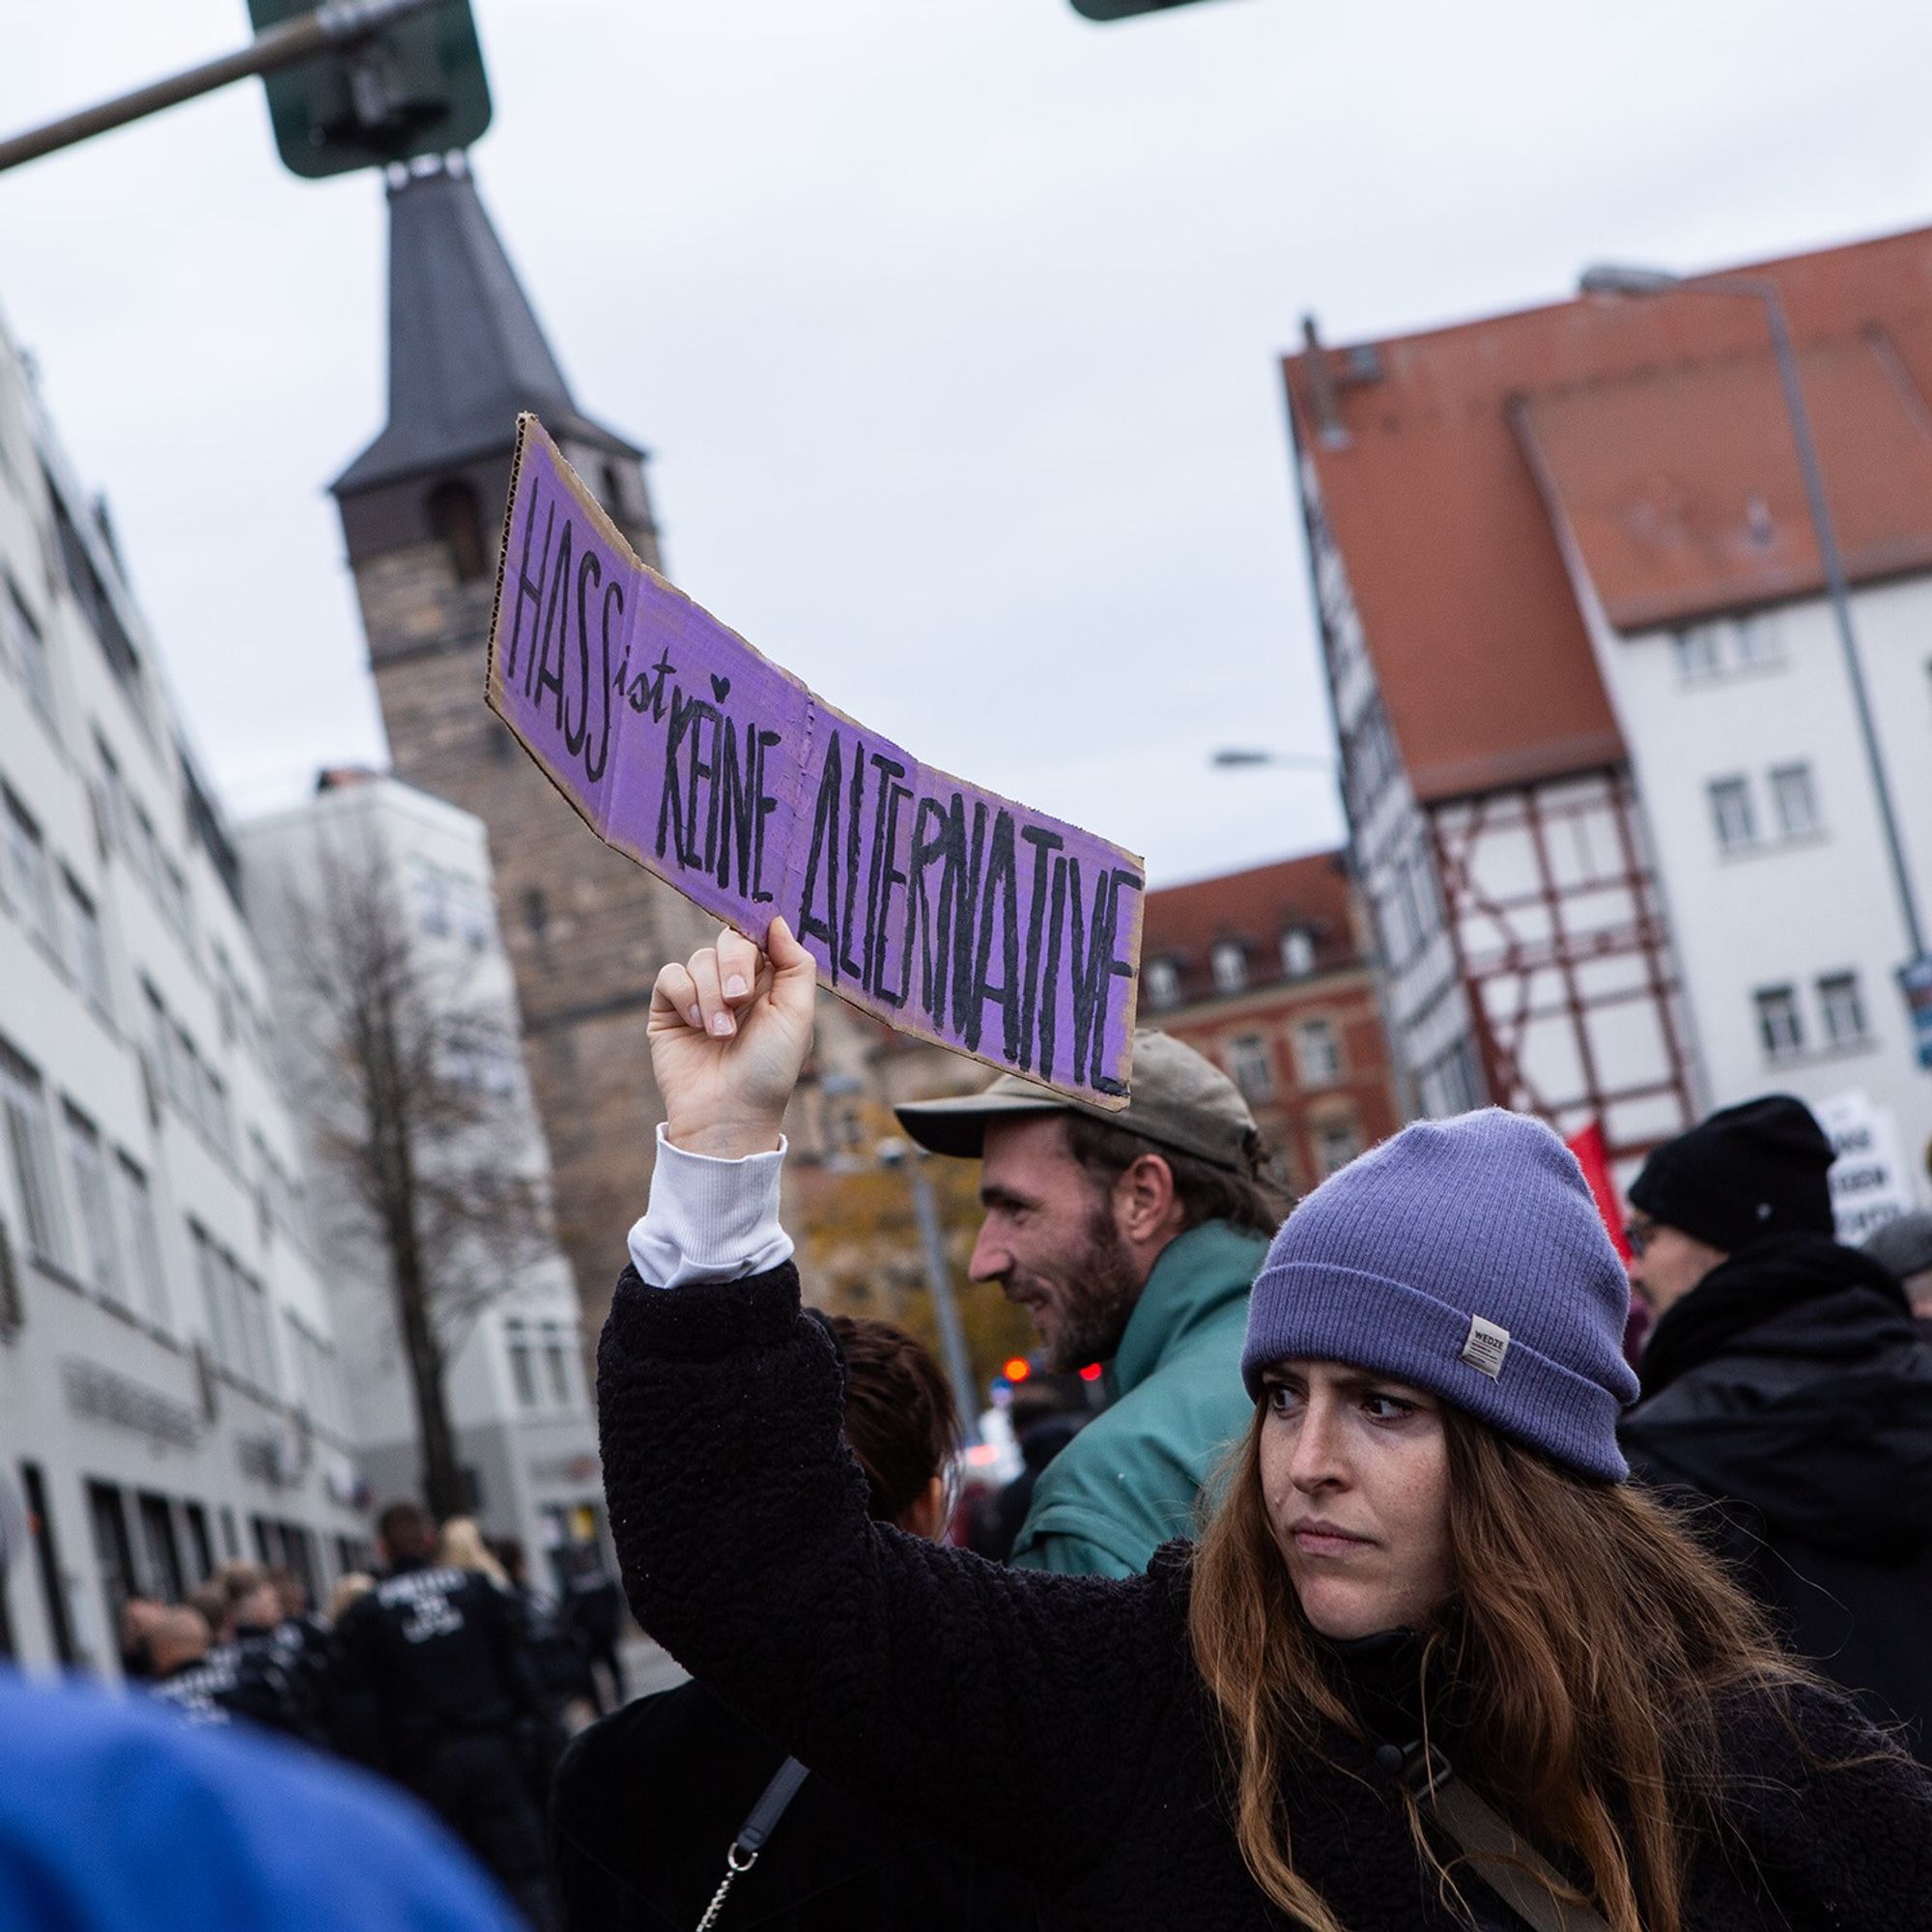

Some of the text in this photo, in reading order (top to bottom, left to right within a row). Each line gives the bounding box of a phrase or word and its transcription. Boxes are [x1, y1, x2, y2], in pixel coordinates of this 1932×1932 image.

[508, 476, 1142, 1095] HASS ist KEINE ALTERNATIVE
[1475, 1331, 1504, 1350] WEDZE
